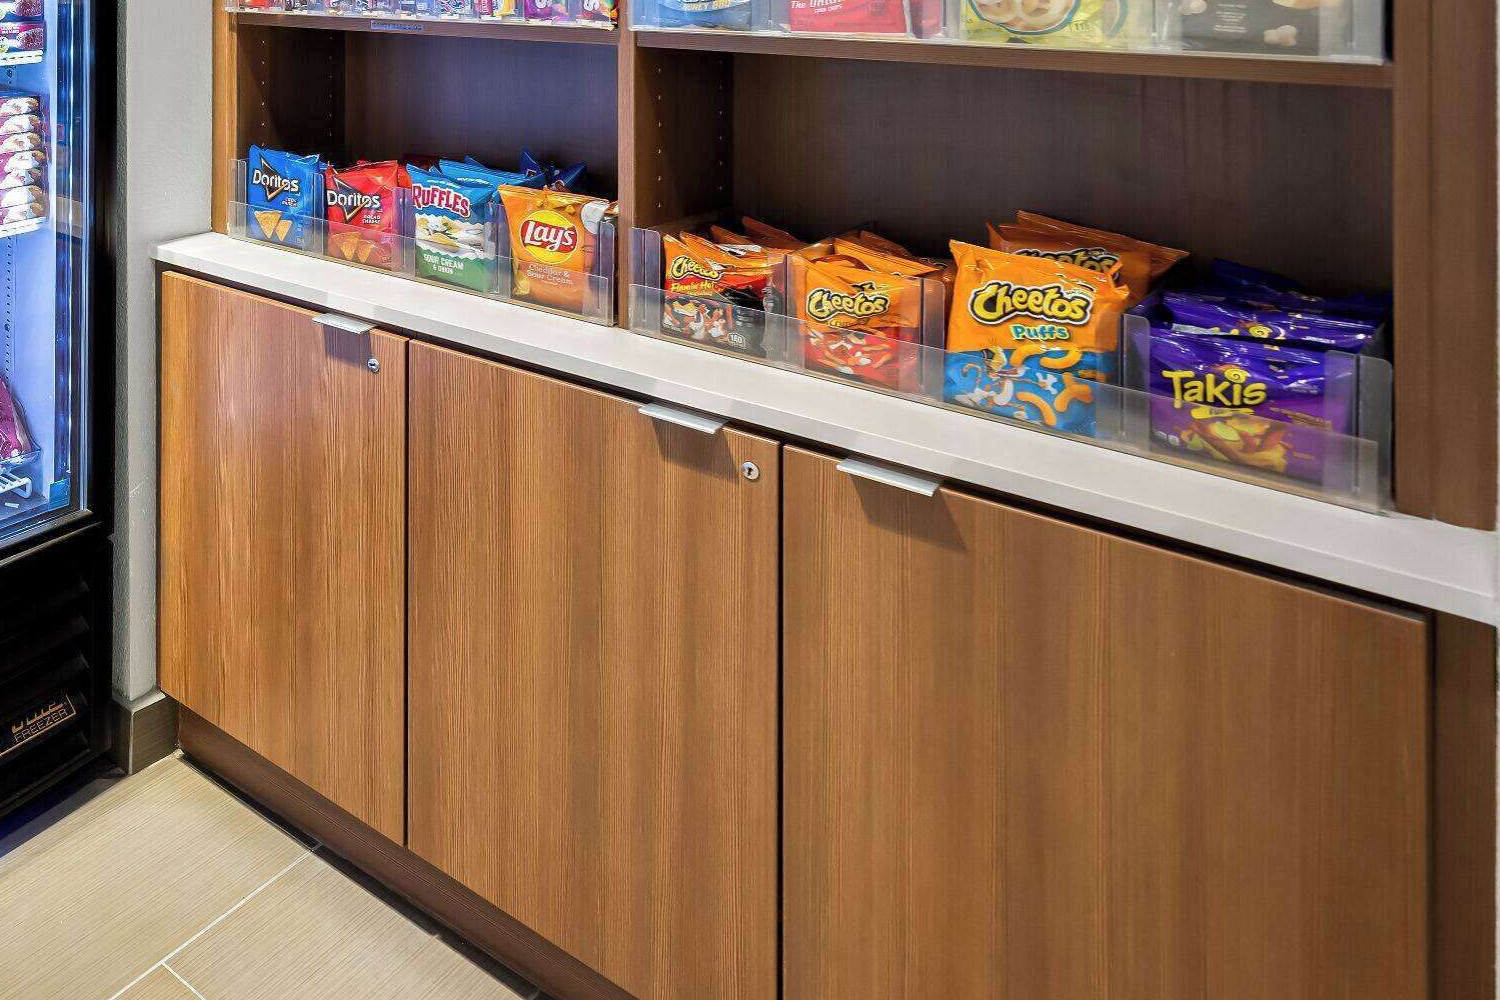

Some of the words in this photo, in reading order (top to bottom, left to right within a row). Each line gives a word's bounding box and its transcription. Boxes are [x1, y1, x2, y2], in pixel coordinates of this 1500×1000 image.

[253, 169, 299, 196] Doritos
[327, 189, 381, 214] Doritos
[411, 183, 471, 219] RUFFLES
[523, 220, 577, 251] Lay's
[440, 257, 464, 271] CREAM
[671, 256, 722, 281] Cheetos
[807, 291, 890, 321] Cheetos
[966, 280, 1096, 327] Cheetos
[1009, 324, 1071, 342] Puffs
[1162, 368, 1268, 409] Takis
